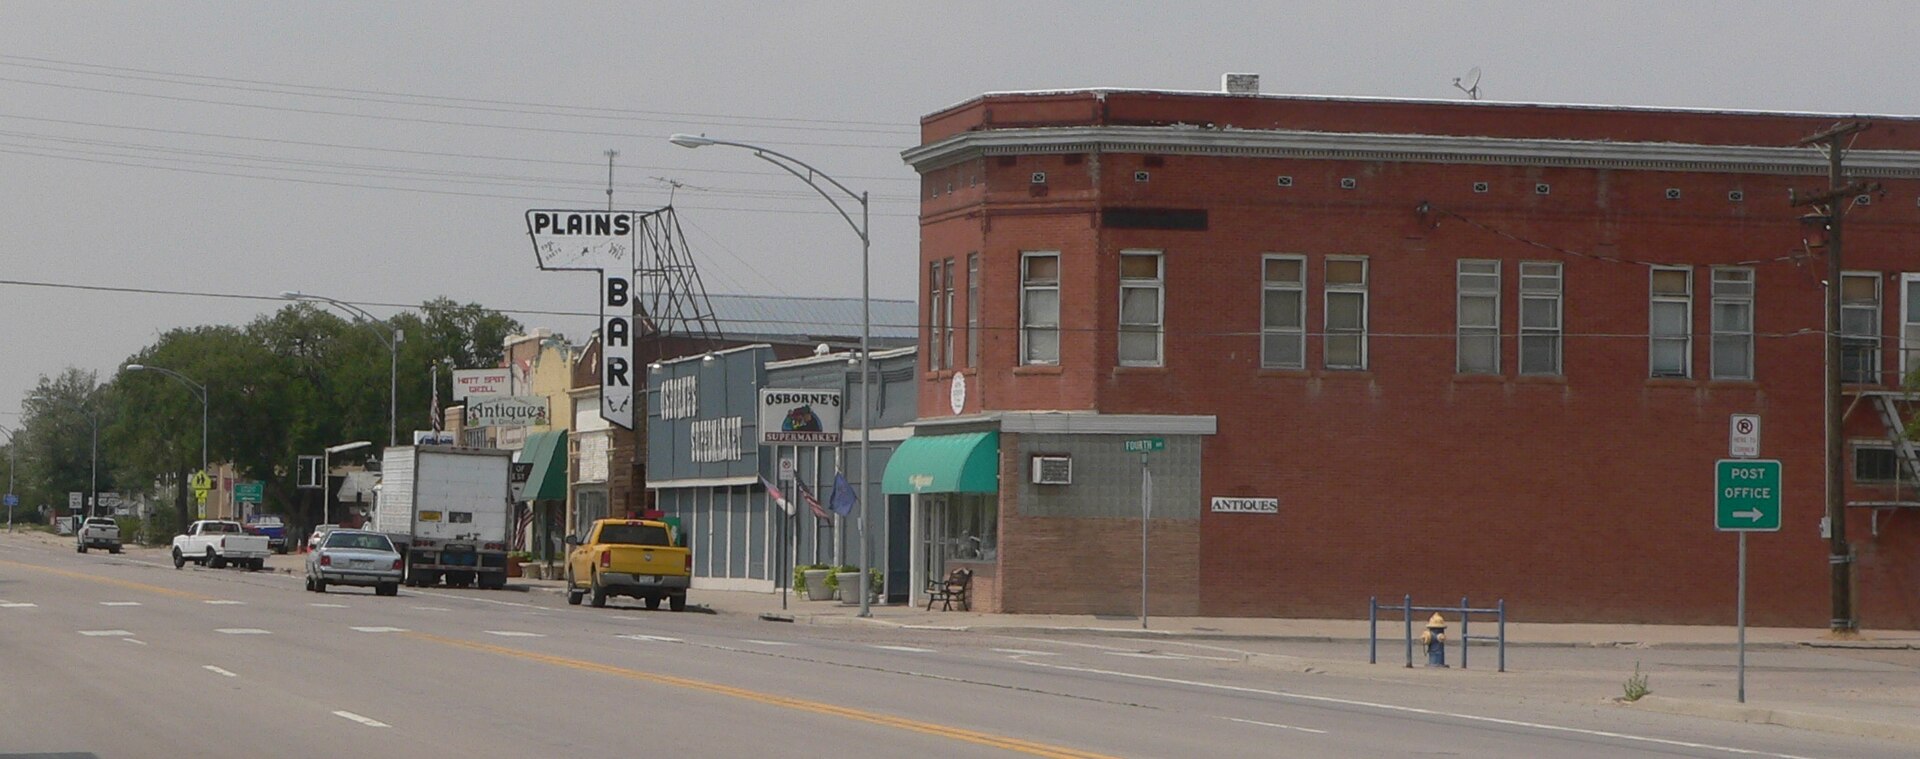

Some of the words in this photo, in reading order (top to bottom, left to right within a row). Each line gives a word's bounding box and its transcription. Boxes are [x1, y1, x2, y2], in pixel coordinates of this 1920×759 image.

[535, 213, 630, 236] PLAINS
[607, 278, 630, 386] BAR
[469, 385, 496, 393] GRILL
[766, 393, 840, 407] OSBORNE'S
[469, 402, 545, 420] Antiques
[766, 432, 837, 442] SUPERMARKET
[1125, 440, 1152, 451] FOURTH
[1731, 468, 1765, 480] POST
[1724, 487, 1771, 499] OFFICE
[1212, 499, 1277, 511] ANTIQUES
